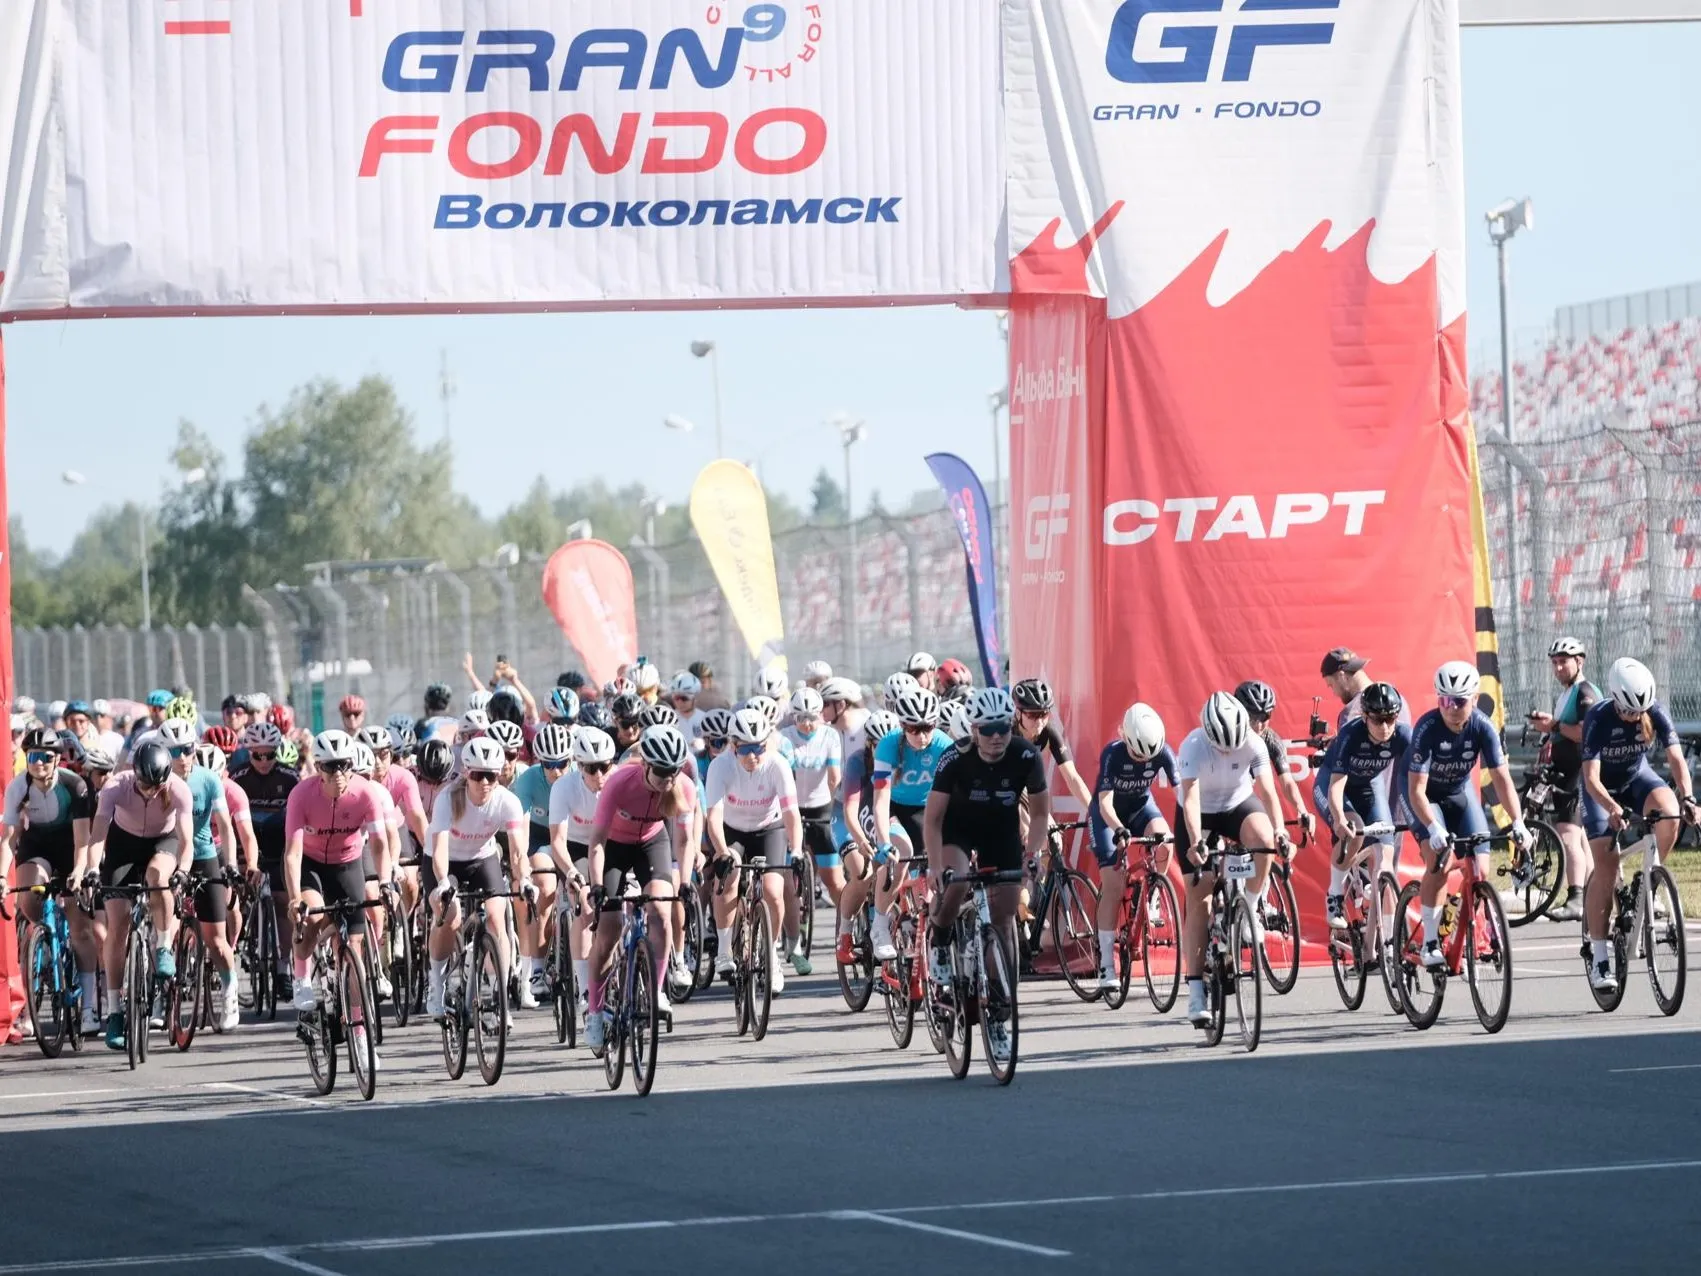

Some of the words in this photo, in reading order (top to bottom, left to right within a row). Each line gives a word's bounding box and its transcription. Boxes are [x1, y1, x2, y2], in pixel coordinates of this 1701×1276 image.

[381, 28, 744, 92] GRAN
[798, 4, 821, 62] FOR
[1106, 0, 1340, 83] GF
[743, 62, 791, 82] ALL
[1093, 104, 1179, 121] GRAN
[1213, 100, 1321, 118] FONDO
[358, 107, 827, 179] FONDO
[433, 194, 902, 229] Волоколамск
[1025, 493, 1070, 561] GF
[1103, 490, 1386, 546] СТАРТ
